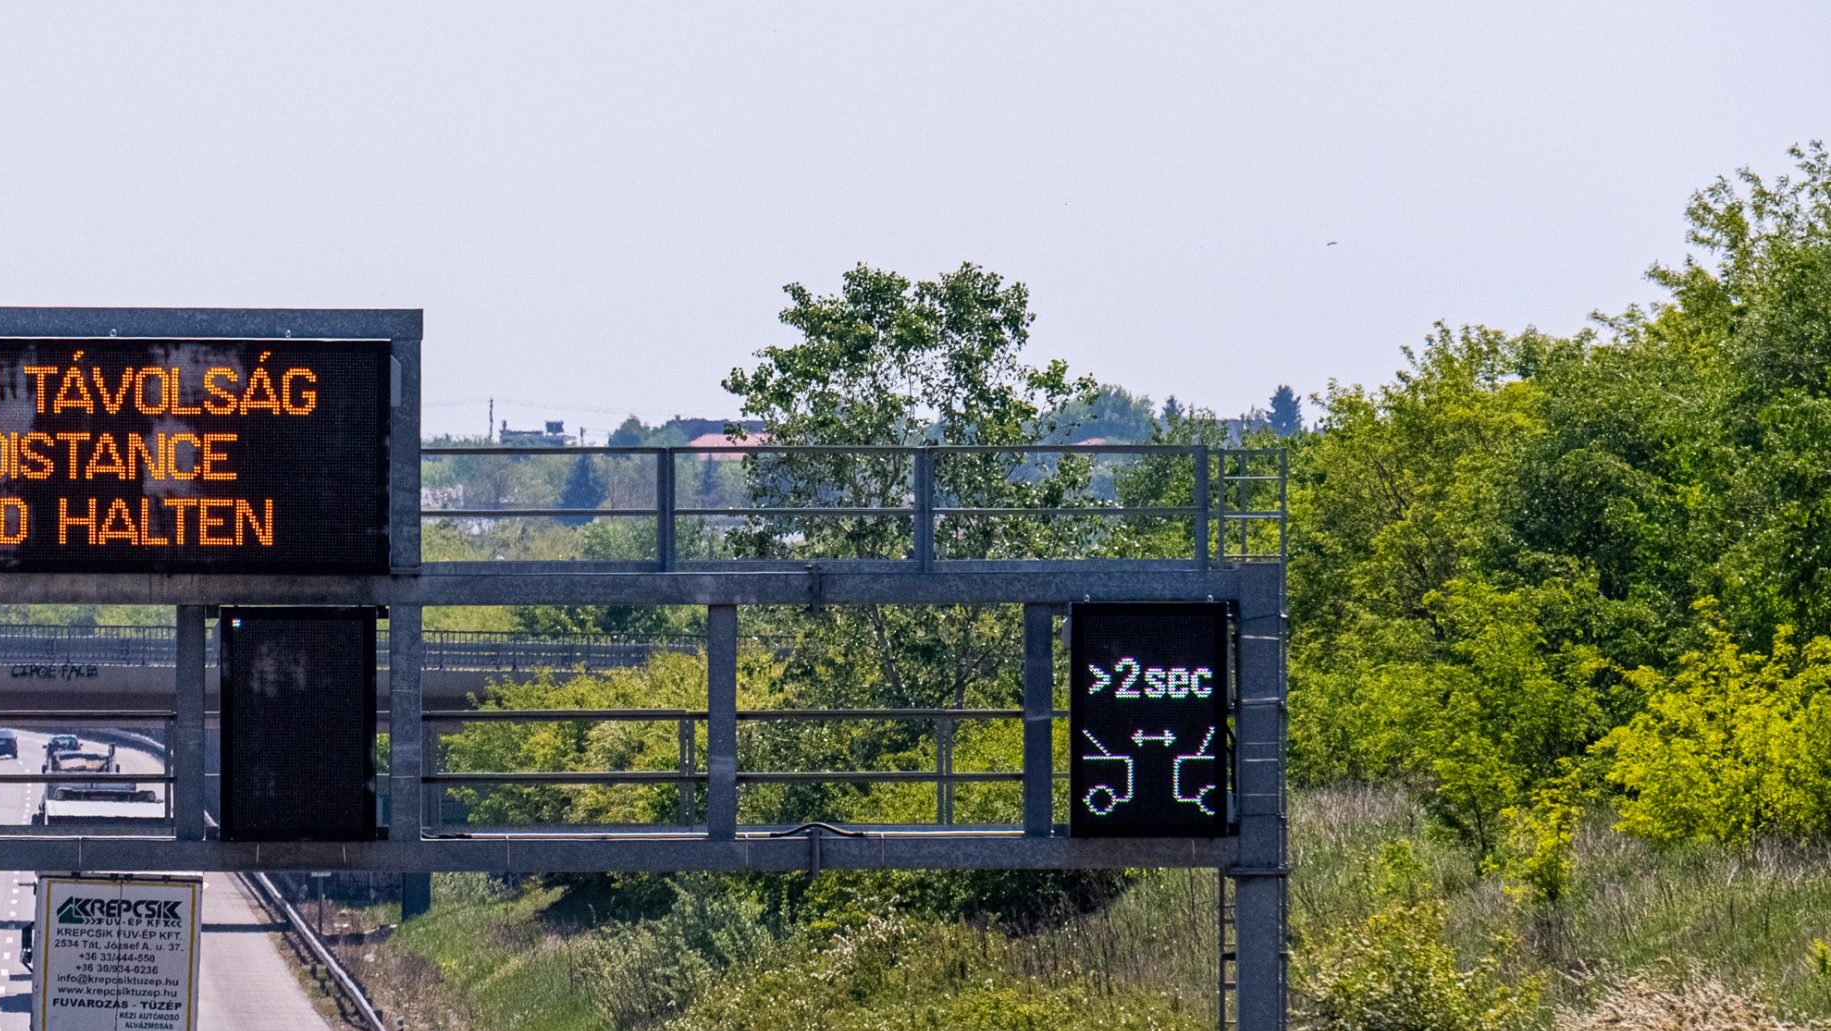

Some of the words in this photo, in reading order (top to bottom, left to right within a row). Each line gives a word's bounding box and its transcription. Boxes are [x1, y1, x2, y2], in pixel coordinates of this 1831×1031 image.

[24, 350, 317, 415] TÁVOLSÁG
[58, 496, 274, 547] HALTEN
[72, 897, 183, 920] KREPCSIK
[56, 928, 113, 938] KREPCSIK
[54, 939, 79, 948] 2534
[104, 941, 139, 950] József
[79, 952, 97, 961] +36
[100, 953, 155, 963] 33/444-550
[75, 963, 94, 973] +36
[57, 974, 179, 987] info@krepcsiktuzep.hu
[57, 986, 177, 998] www.krepcsiktuzep.hu
